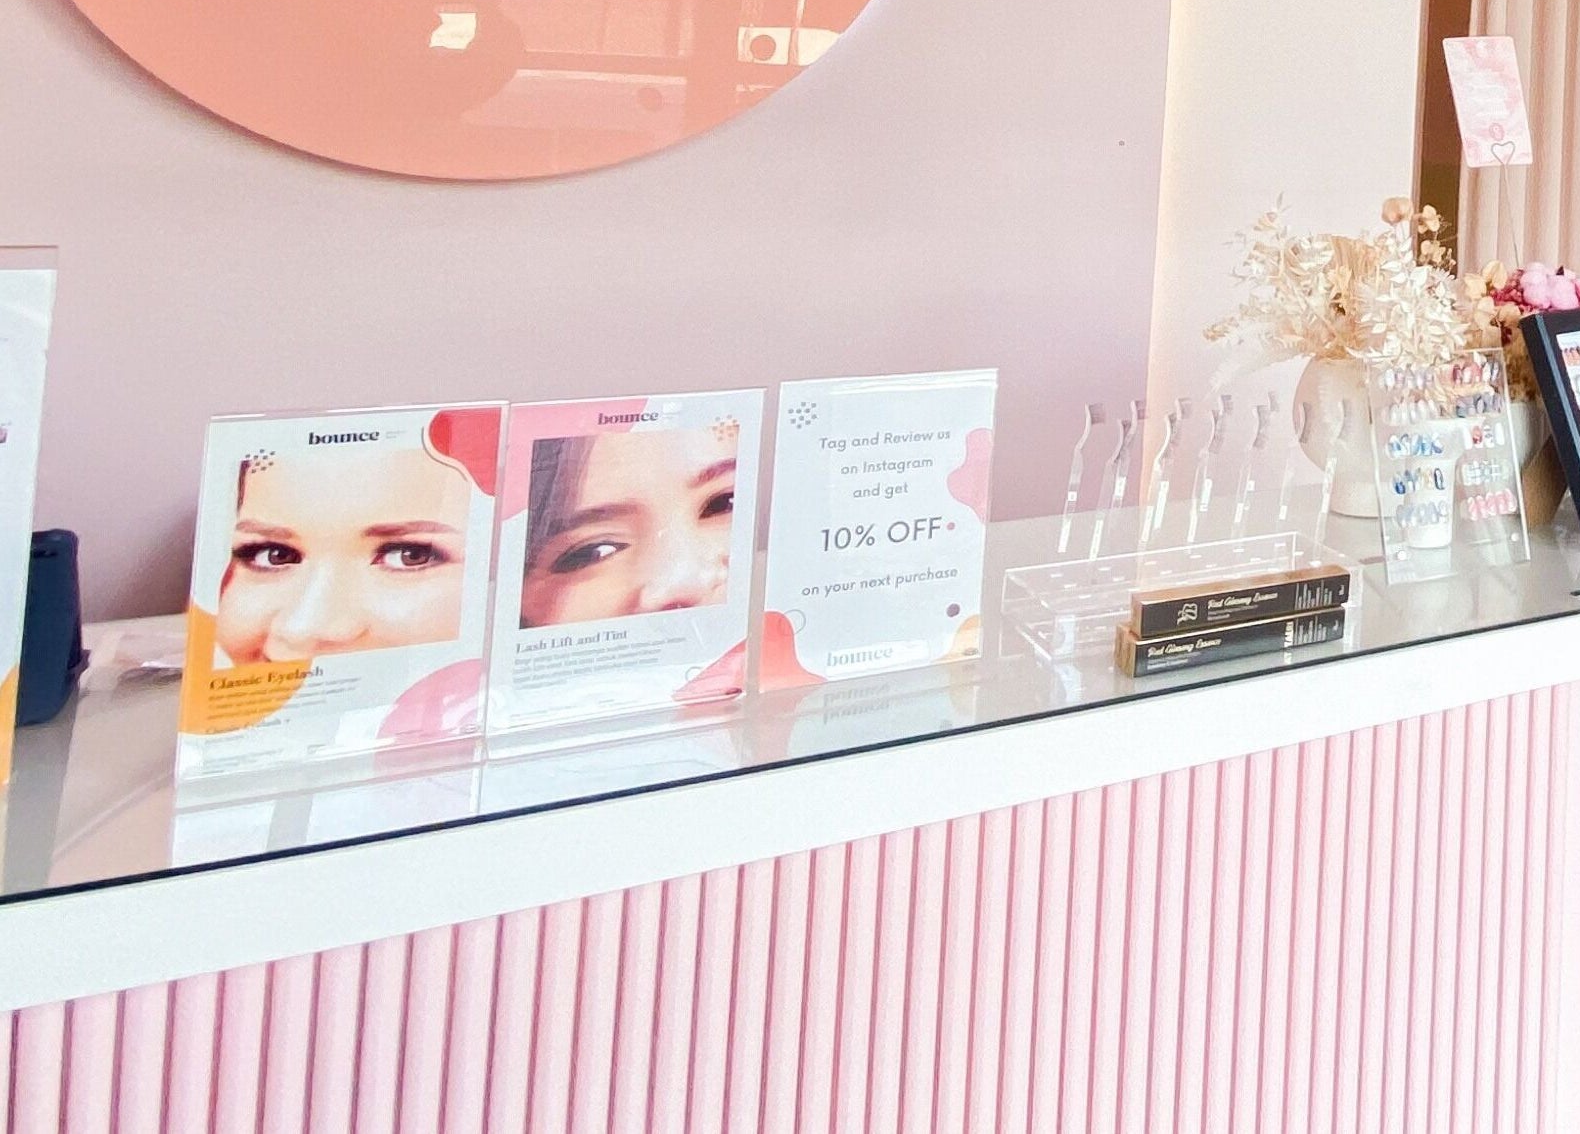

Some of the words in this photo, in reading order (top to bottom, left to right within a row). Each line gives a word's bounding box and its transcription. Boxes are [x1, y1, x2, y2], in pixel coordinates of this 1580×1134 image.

[598, 412, 659, 425] bounce
[308, 431, 380, 446] bounce
[819, 437, 847, 452] Tag
[852, 432, 880, 447] and
[883, 431, 934, 444] Review
[937, 430, 951, 440] us
[841, 465, 858, 475] on
[863, 458, 934, 474] Instagram
[853, 483, 881, 498] and
[885, 482, 909, 499] get
[821, 523, 876, 552] 10%
[887, 516, 943, 543] OFF
[801, 585, 820, 597] on
[824, 580, 856, 598] your
[860, 575, 891, 590] next
[895, 567, 959, 590] purchase
[516, 640, 547, 654] Lash
[551, 636, 573, 649] Lift
[577, 632, 601, 645] and
[602, 630, 628, 642] Tint
[827, 647, 894, 667] bounce
[209, 675, 262, 690] Classic
[267, 666, 324, 684] Eyelash
